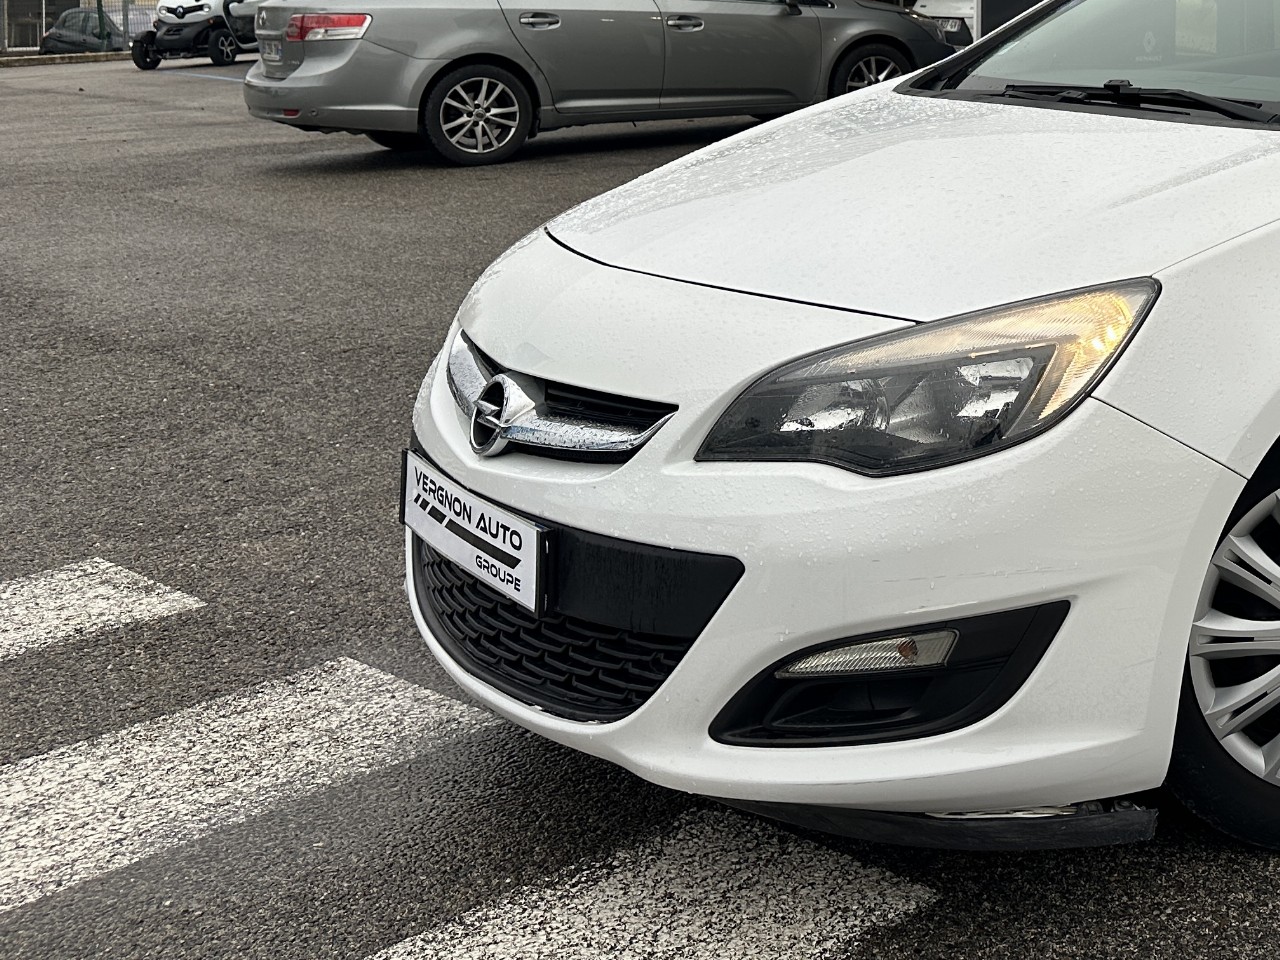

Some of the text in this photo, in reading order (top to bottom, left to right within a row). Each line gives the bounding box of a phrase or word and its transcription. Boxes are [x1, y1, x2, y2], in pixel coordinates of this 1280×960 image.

[414, 465, 523, 552] VERGNON AUTO
[475, 554, 522, 593] GROUPE
